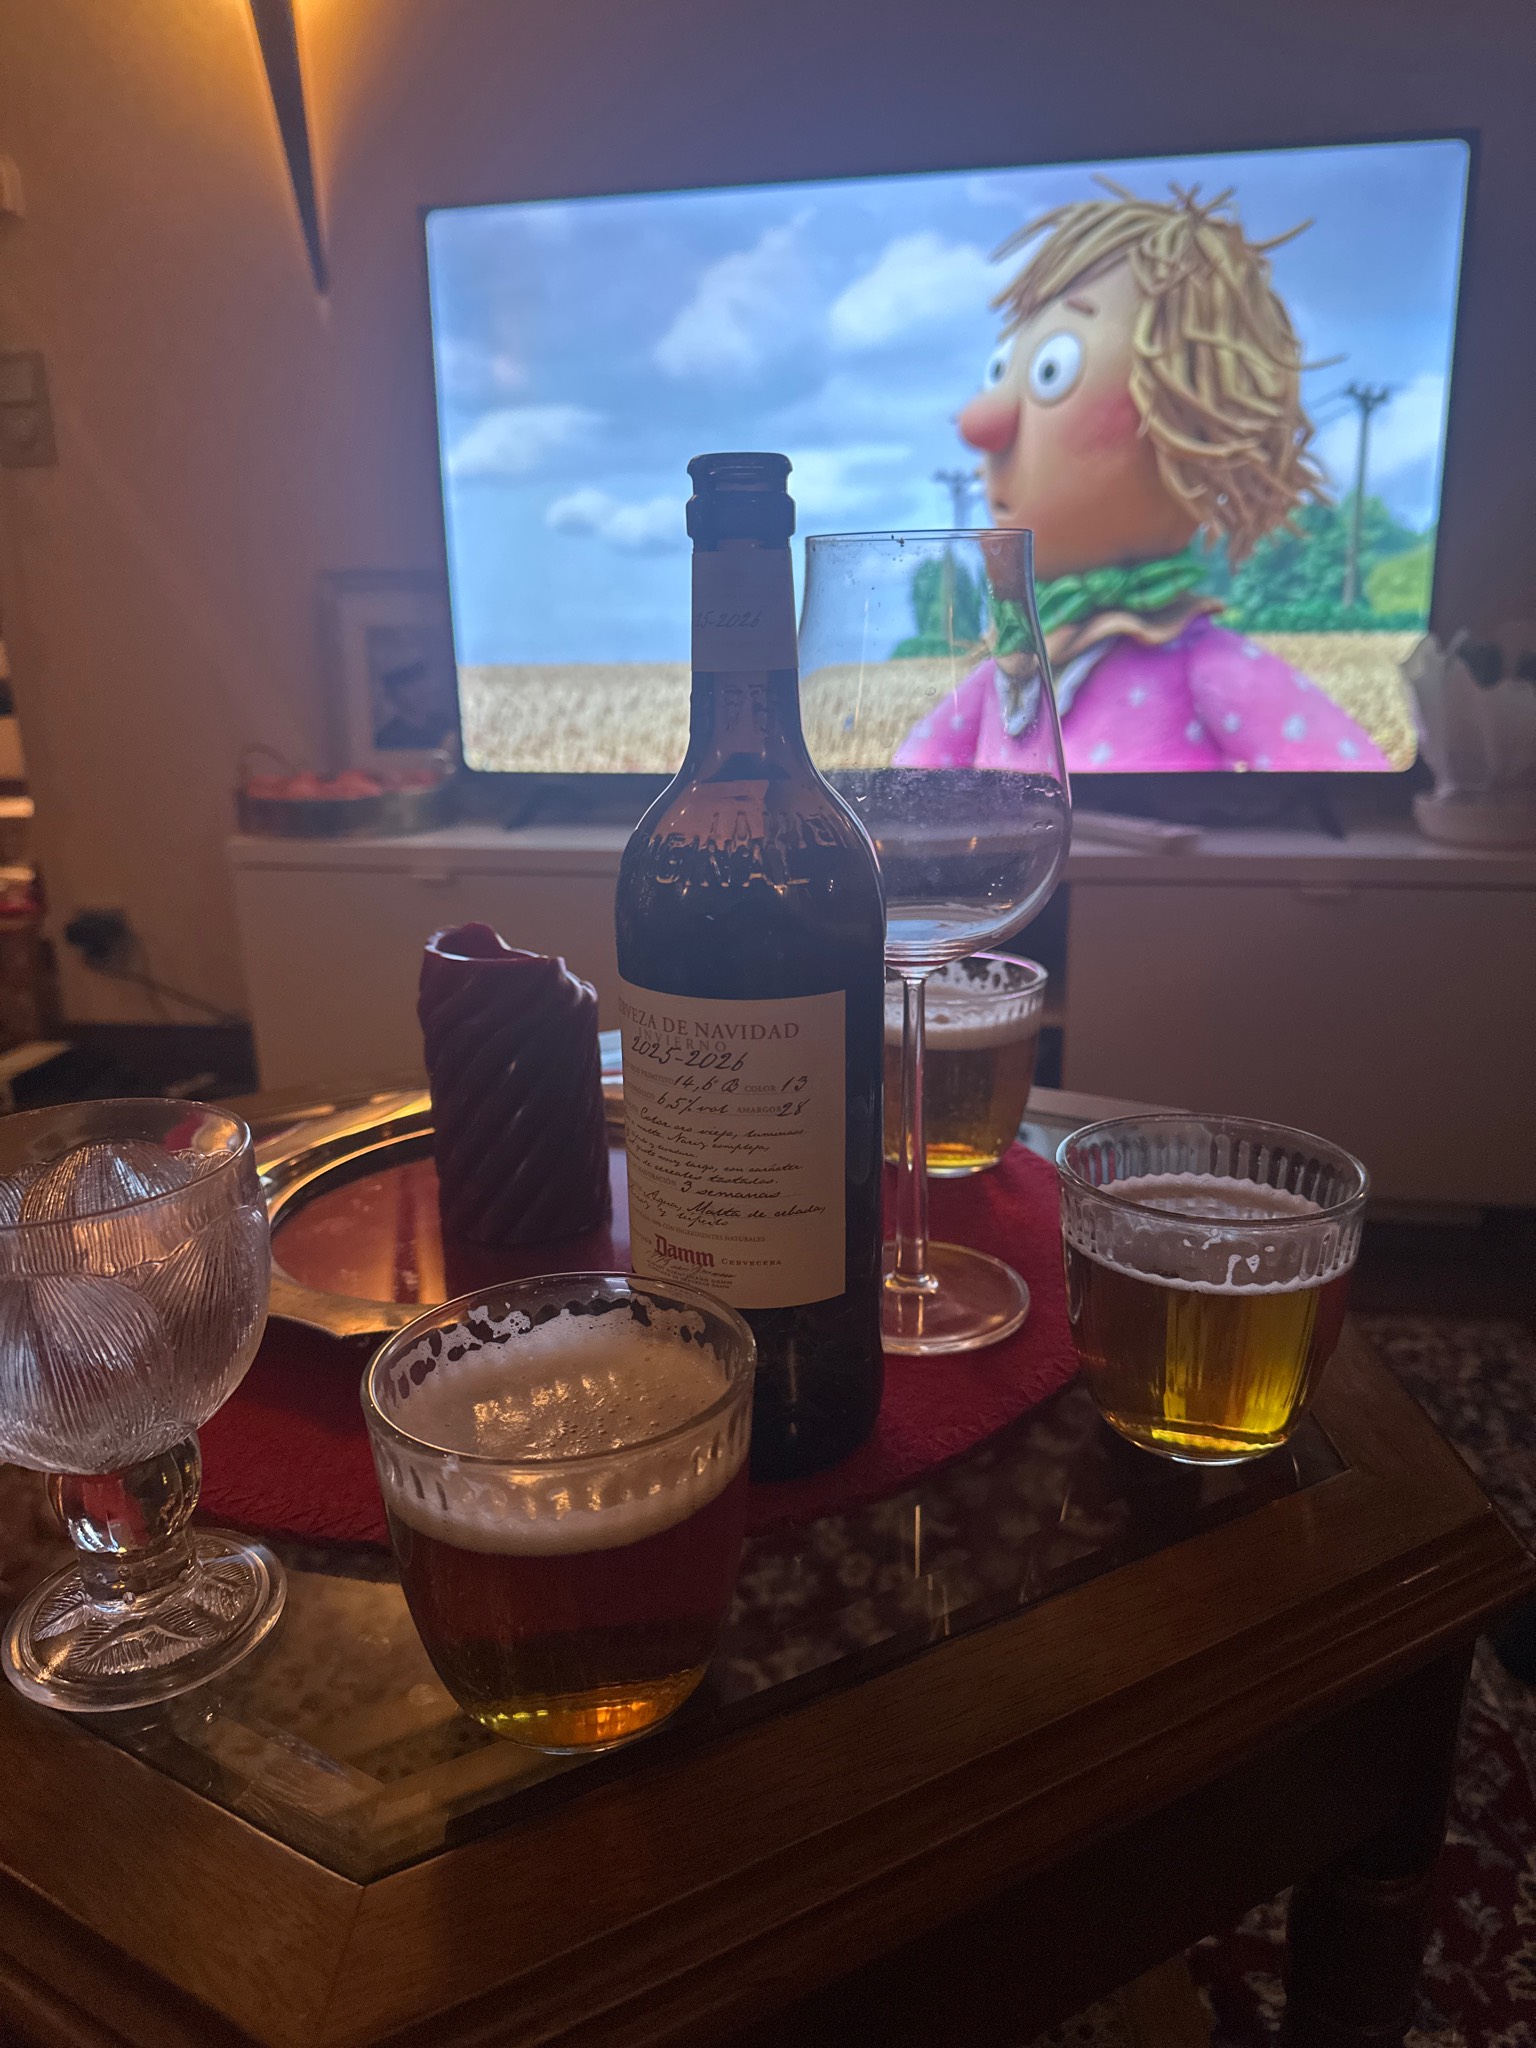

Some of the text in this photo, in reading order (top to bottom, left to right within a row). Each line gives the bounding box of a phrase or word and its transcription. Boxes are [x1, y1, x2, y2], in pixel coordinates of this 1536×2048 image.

[695, 609, 763, 628] 25-2026
[619, 997, 800, 1040] ERVEZA DE NAVIDAD
[638, 1027, 727, 1052] INVIERNO
[631, 1035, 749, 1072] 2025-2026
[744, 1084, 777, 1093] COLOR
[781, 1075, 808, 1092] 13
[737, 1106, 782, 1114] AMARGOR
[777, 1098, 812, 1117] 28
[640, 1107, 671, 1128] Color
[681, 1180, 692, 1193] 3
[695, 1189, 781, 1199] semanas
[658, 1208, 667, 1217] y
[687, 1201, 741, 1217] Malta
[747, 1210, 767, 1218] de
[774, 1205, 826, 1217] cebada,
[654, 1233, 716, 1268] Damm
